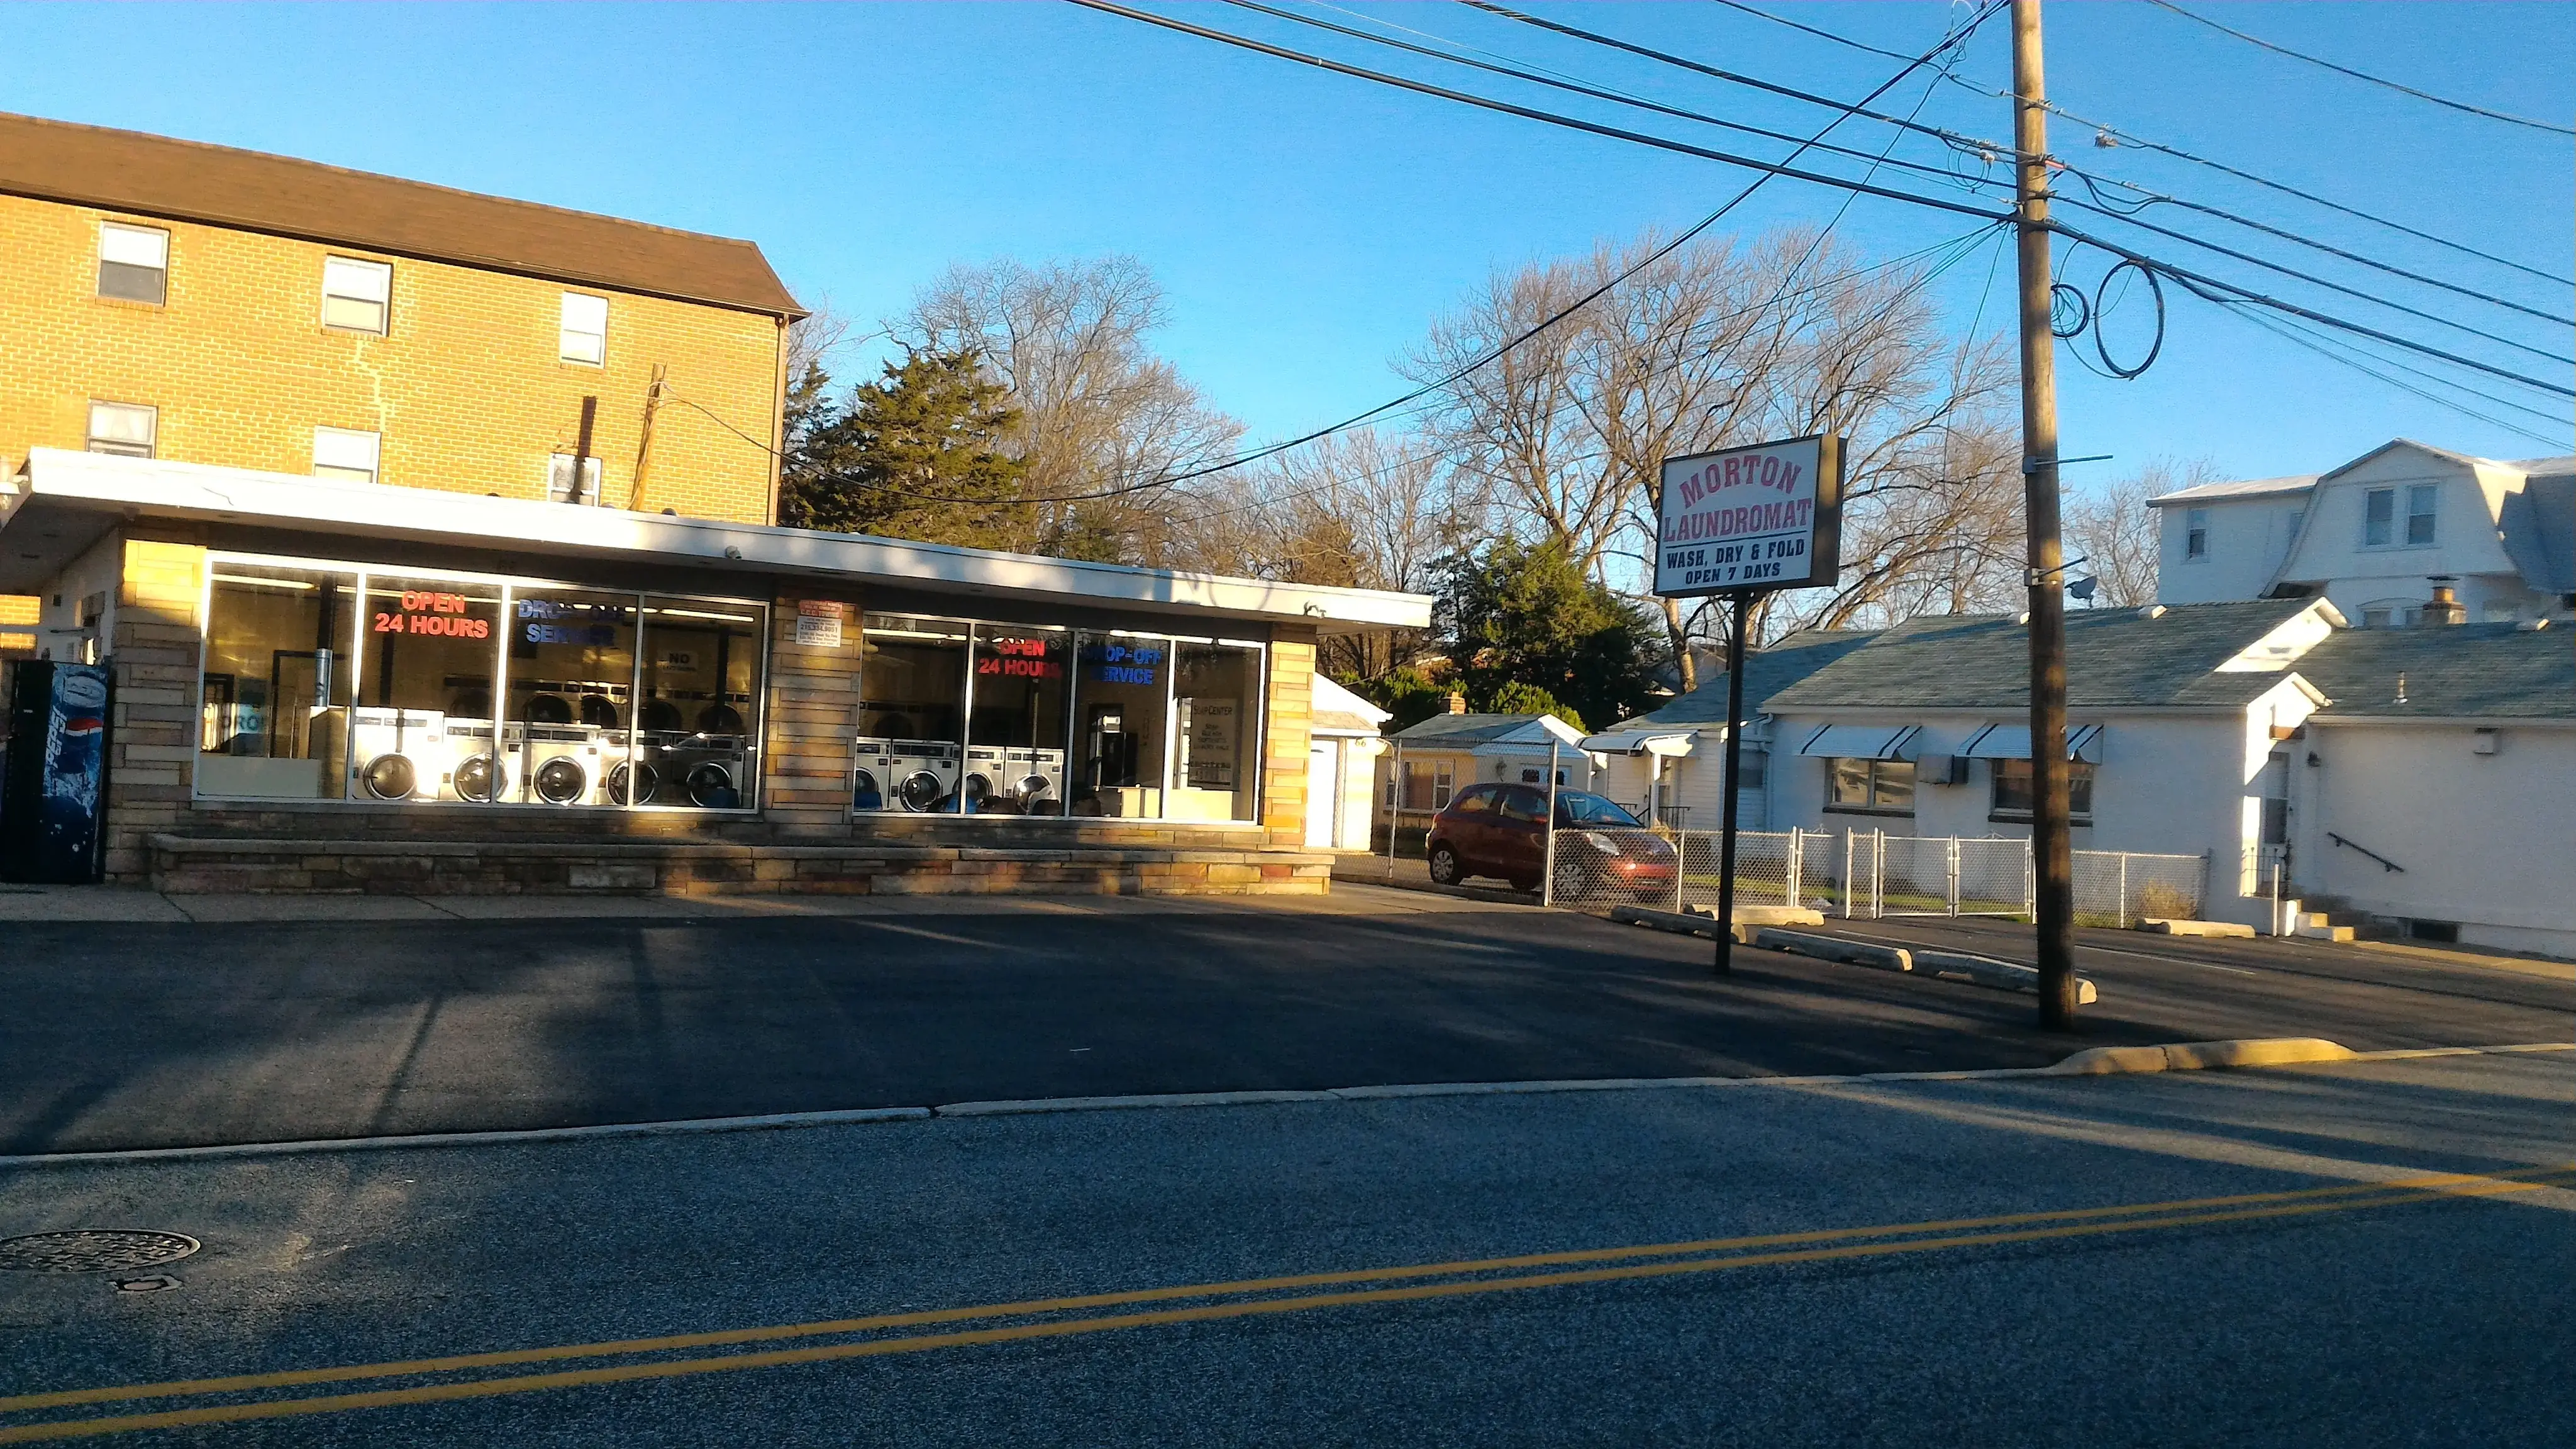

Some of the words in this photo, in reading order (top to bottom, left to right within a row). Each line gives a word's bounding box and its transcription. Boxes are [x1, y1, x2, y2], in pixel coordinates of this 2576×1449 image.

[1679, 455, 1802, 509] MORTON
[1663, 498, 1812, 542] LAUNDROMAT
[1667, 548, 1708, 569] WASH,
[1716, 545, 1743, 564] DRY
[1752, 544, 1759, 560] &
[1768, 539, 1804, 559] FOLD
[1685, 567, 1721, 585] OPEN
[1728, 567, 1736, 580] 7
[1744, 562, 1780, 579] DAYS
[402, 590, 466, 614] OPEN
[375, 613, 404, 633] 24
[410, 615, 489, 638] HOURS
[669, 653, 690, 664] NO
[1000, 638, 1046, 657] OPEN
[979, 658, 1001, 674] 24
[45, 704, 68, 769] PEPSI
